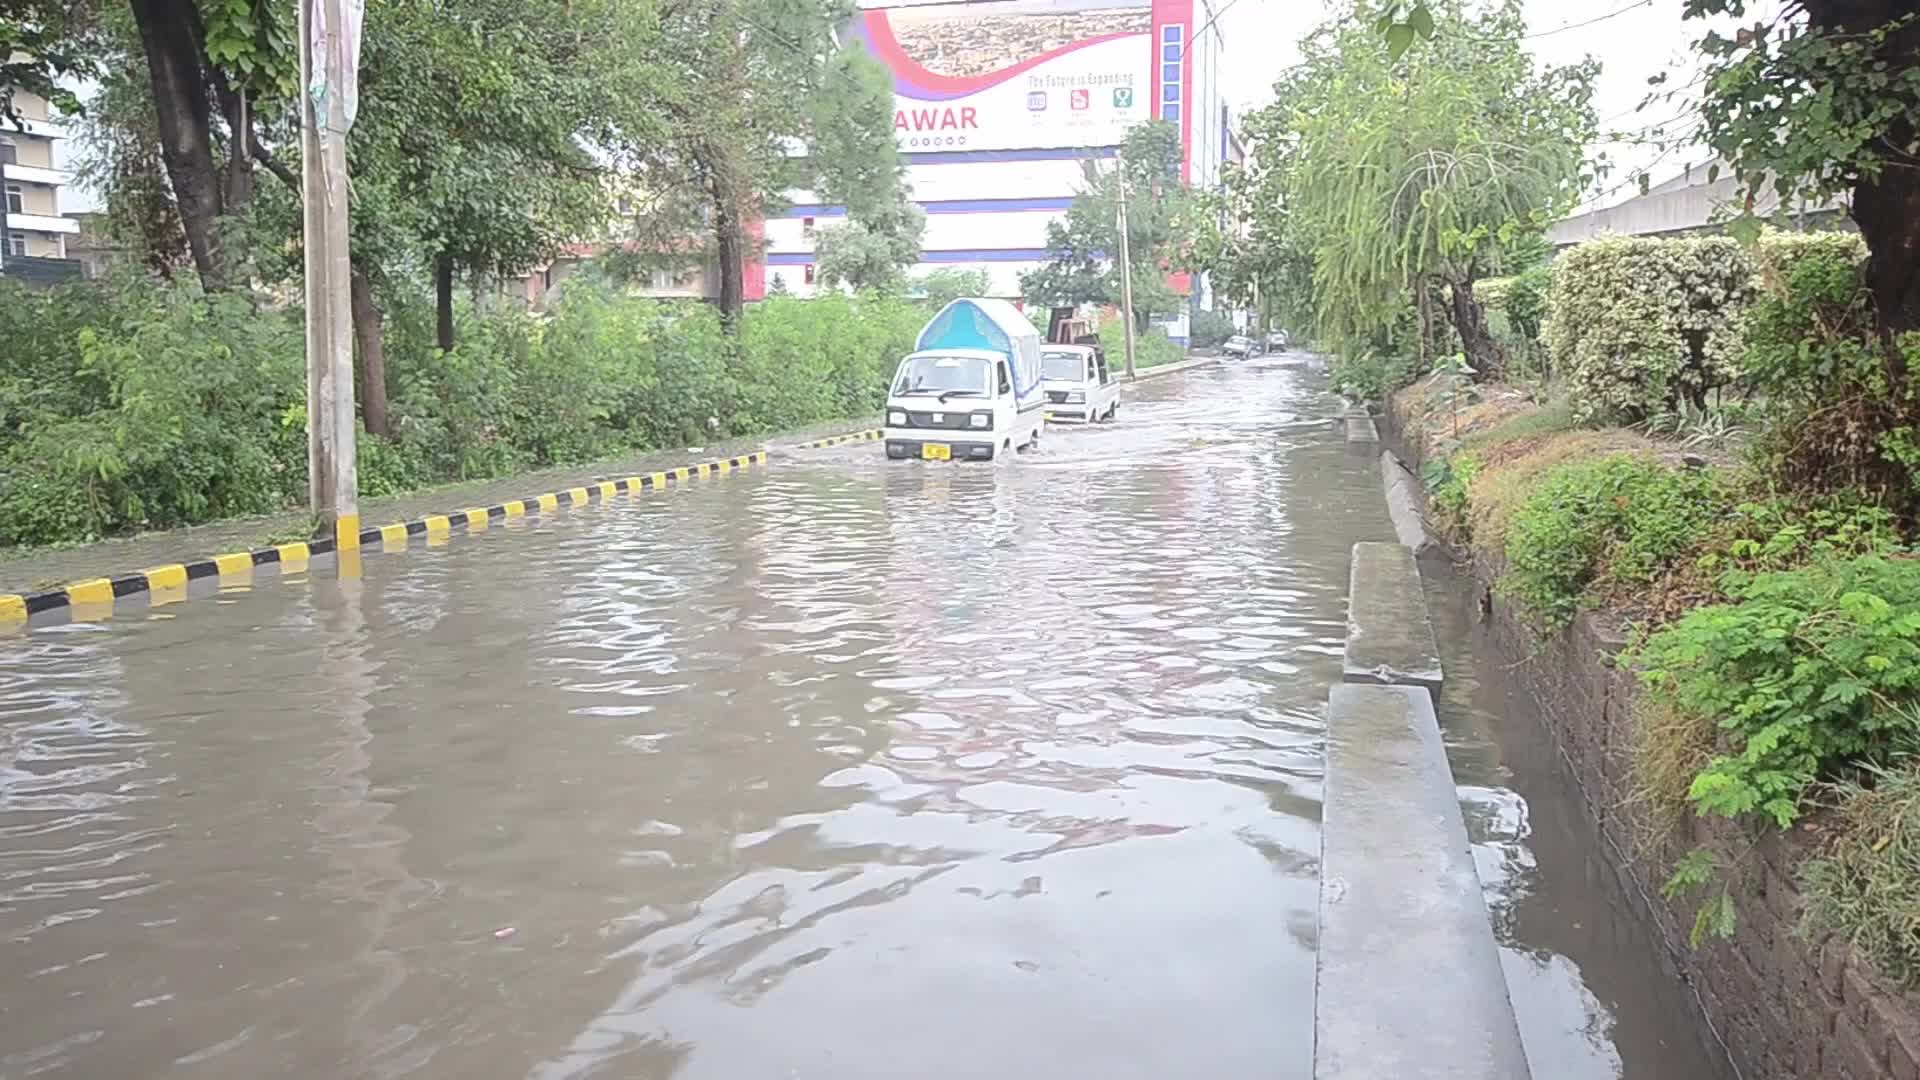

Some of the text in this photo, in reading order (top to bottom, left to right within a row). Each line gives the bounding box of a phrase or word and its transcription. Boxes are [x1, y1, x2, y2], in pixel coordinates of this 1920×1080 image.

[1028, 75, 1043, 88] The
[1046, 74, 1075, 88] Future
[1088, 72, 1134, 87] Expanding
